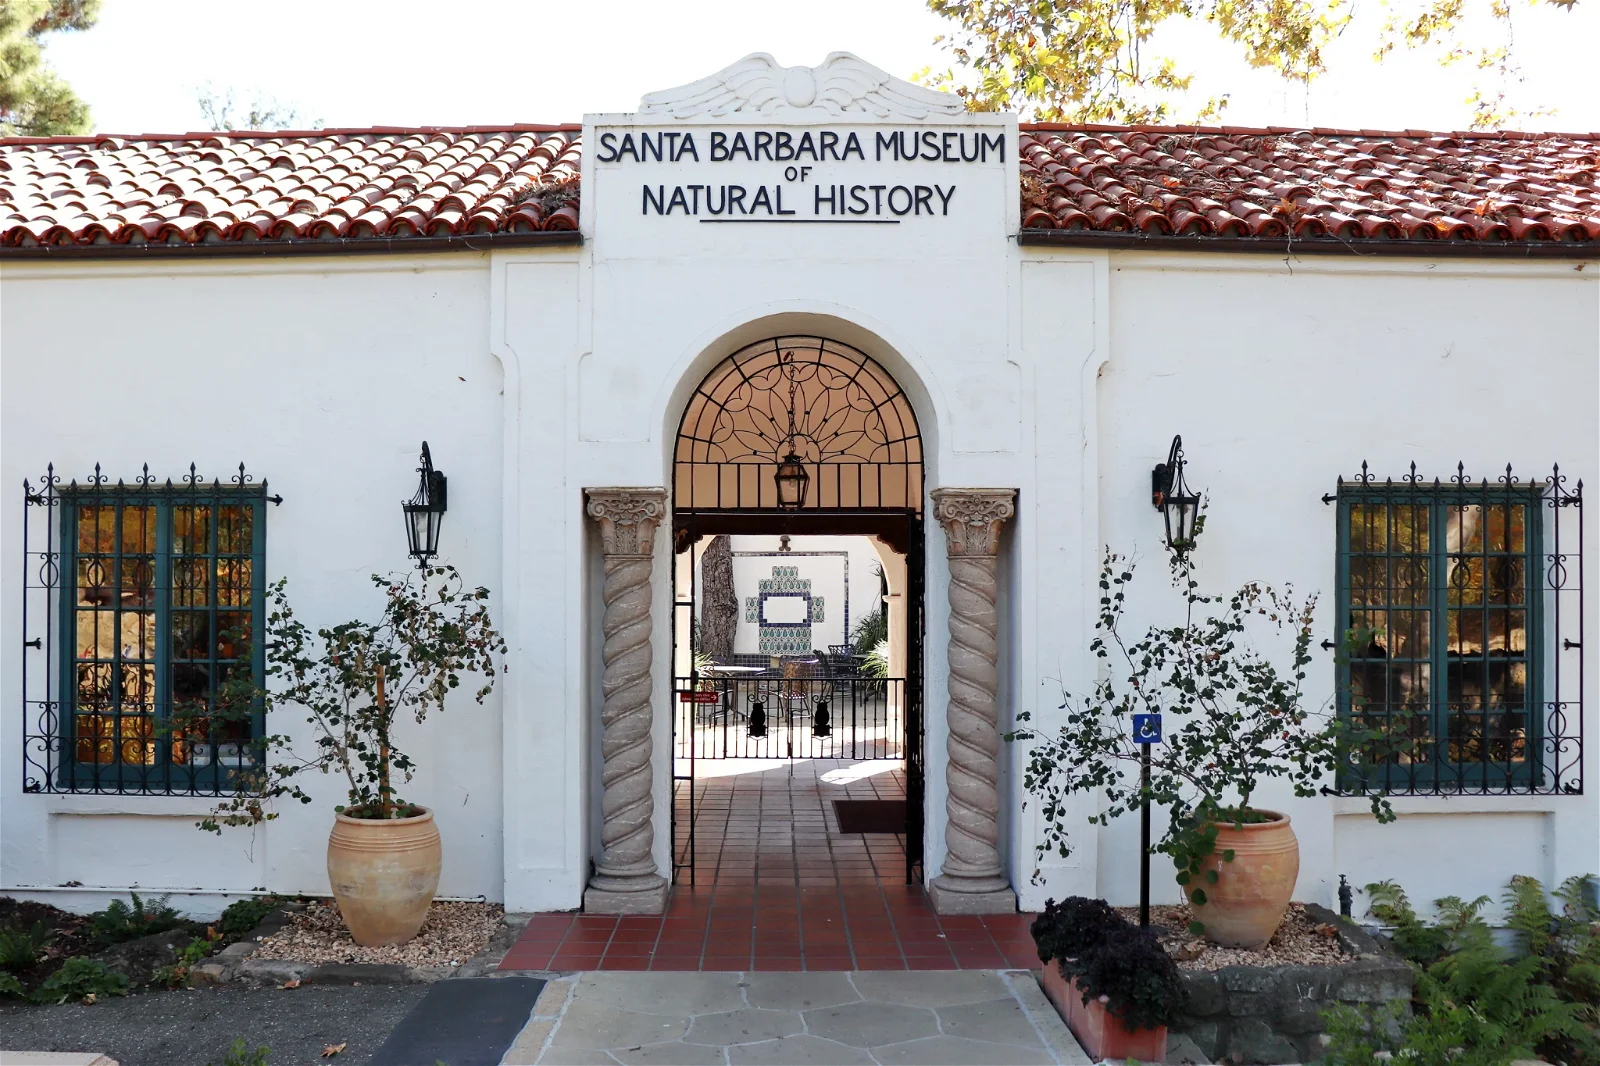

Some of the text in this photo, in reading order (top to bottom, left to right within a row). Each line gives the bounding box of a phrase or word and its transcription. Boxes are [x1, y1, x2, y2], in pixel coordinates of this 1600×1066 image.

[597, 131, 1006, 163] SANTA BARBARA MUSEUM
[784, 166, 813, 182] OF
[642, 185, 956, 216] NATURAL HISTORY
